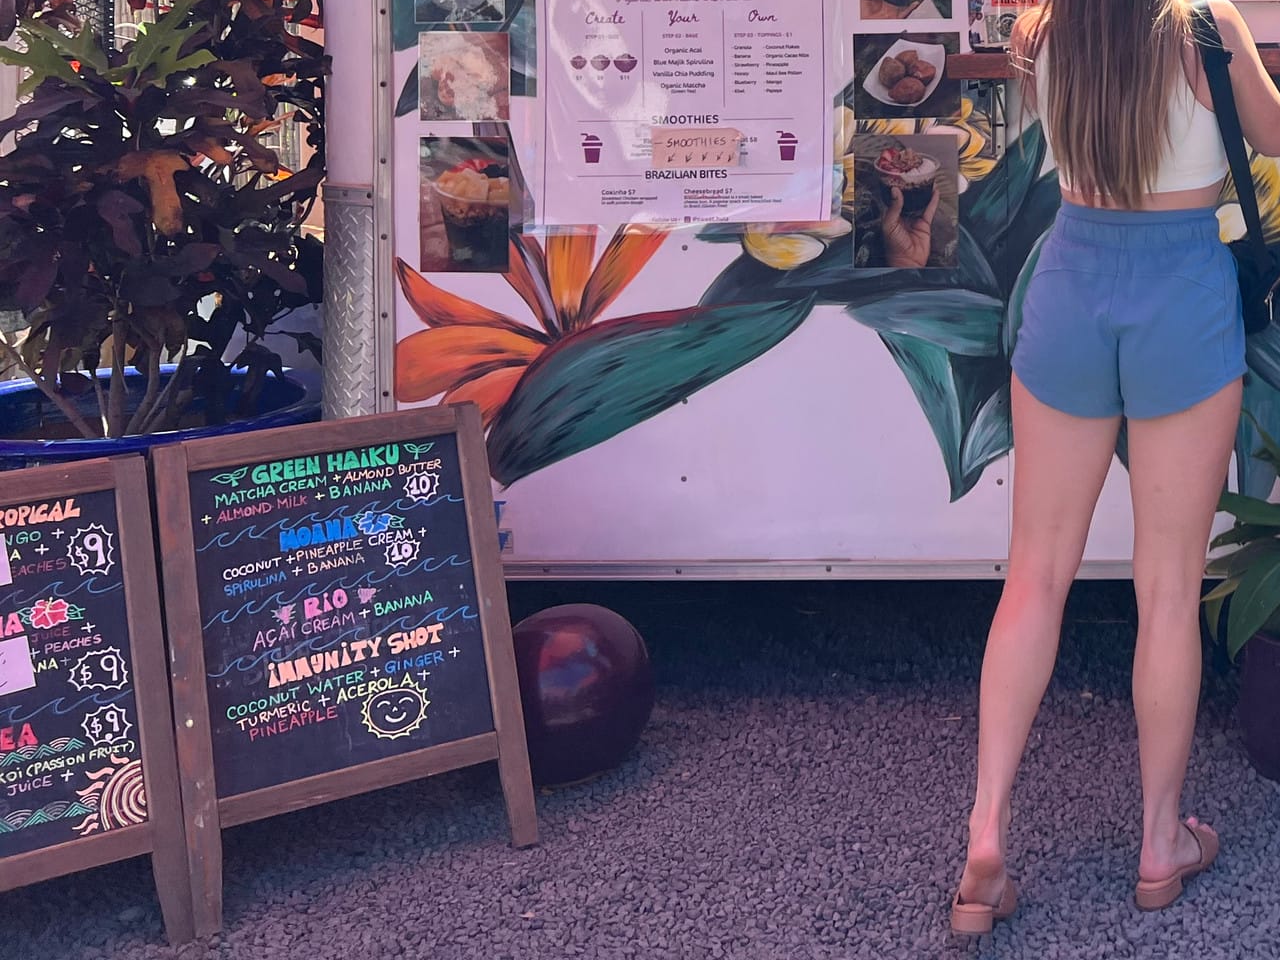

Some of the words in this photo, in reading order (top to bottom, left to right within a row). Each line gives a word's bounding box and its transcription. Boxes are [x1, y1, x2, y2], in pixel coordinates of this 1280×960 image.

[585, 10, 625, 24] Create
[668, 10, 700, 27] Your
[748, 9, 778, 22] Own
[652, 114, 719, 125] SMOOTHIES
[666, 137, 727, 148] SMOOTHIES
[645, 170, 697, 179] BRAZILIAN
[699, 169, 727, 179] BITES
[215, 486, 276, 508] MATCHA
[279, 476, 327, 494] CREAM
[398, 458, 442, 475] BUTTER
[252, 455, 321, 485] GREEN
[0, 498, 80, 529] ROPICAL
[216, 502, 272, 524] ALMOND
[329, 479, 392, 500] BANANA
[280, 516, 358, 552] MOANA
[11, 558, 67, 577] EACHES
[223, 556, 282, 581] COCONUT
[368, 530, 413, 546] CREAM
[307, 552, 365, 574] BANANA
[301, 612, 356, 636] CREAM
[374, 590, 433, 617] BANANA
[45, 634, 102, 654] PEACHES
[387, 623, 444, 655] SHOT
[226, 688, 301, 721] COCONUT
[307, 670, 364, 696] WATER
[336, 672, 413, 704] ACEROLA
[249, 706, 338, 742] PINEAPPLE
